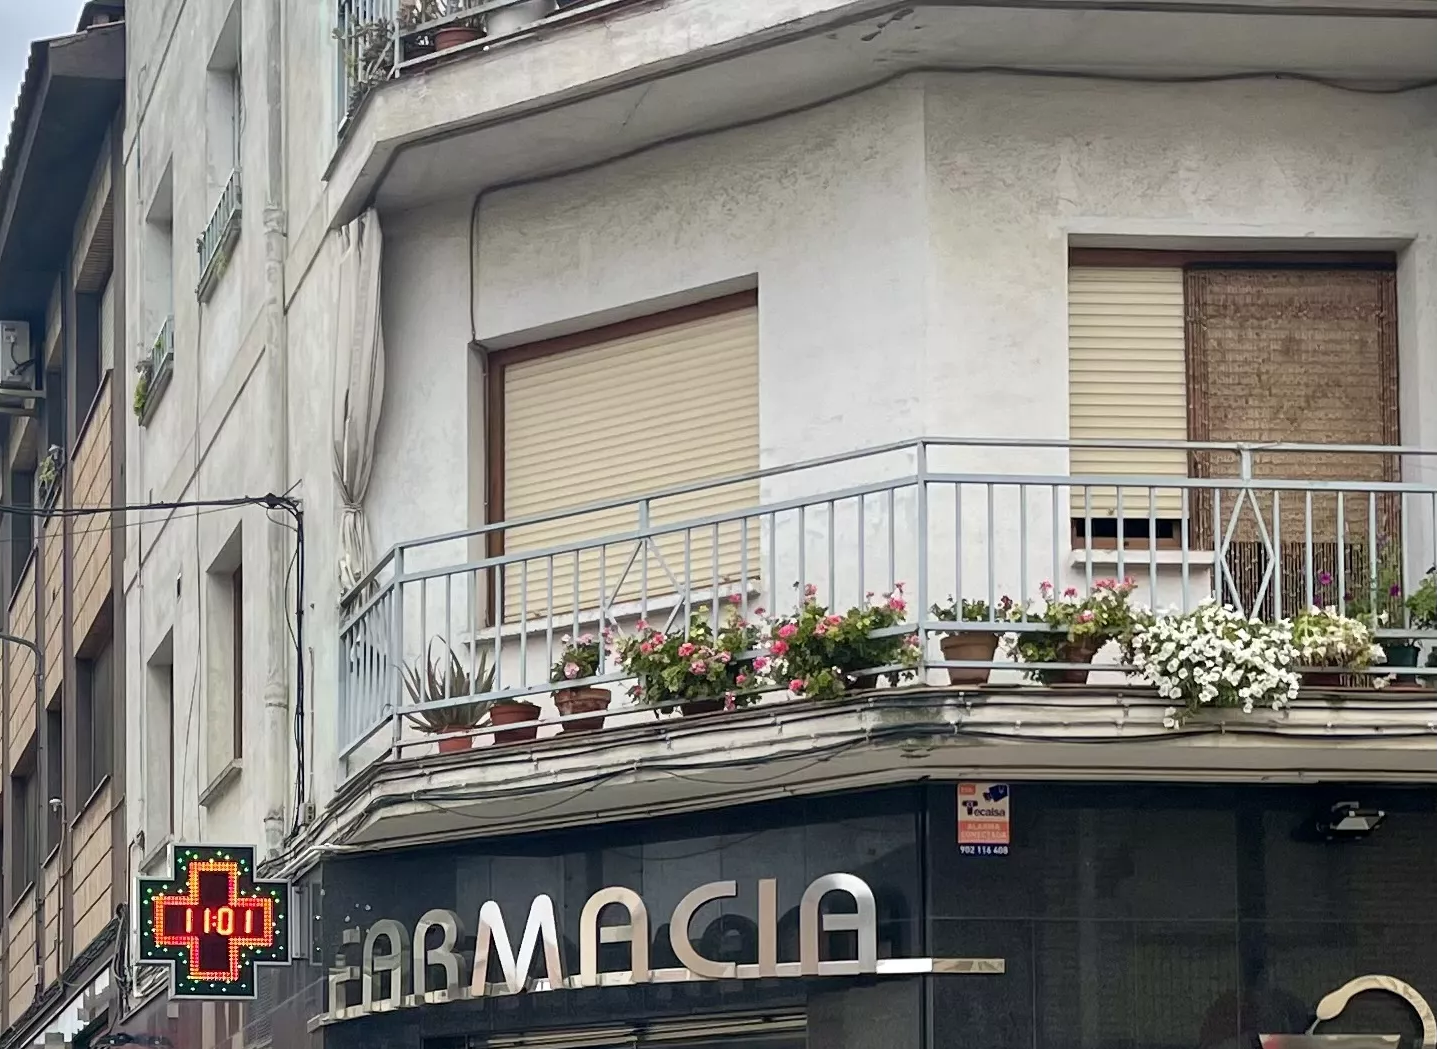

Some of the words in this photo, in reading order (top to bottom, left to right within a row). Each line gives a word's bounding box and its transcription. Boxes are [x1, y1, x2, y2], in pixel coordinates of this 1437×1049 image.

[959, 845, 975, 855] 902
[185, 907, 254, 936] 11:01
[328, 872, 878, 1020] FARMACIA
